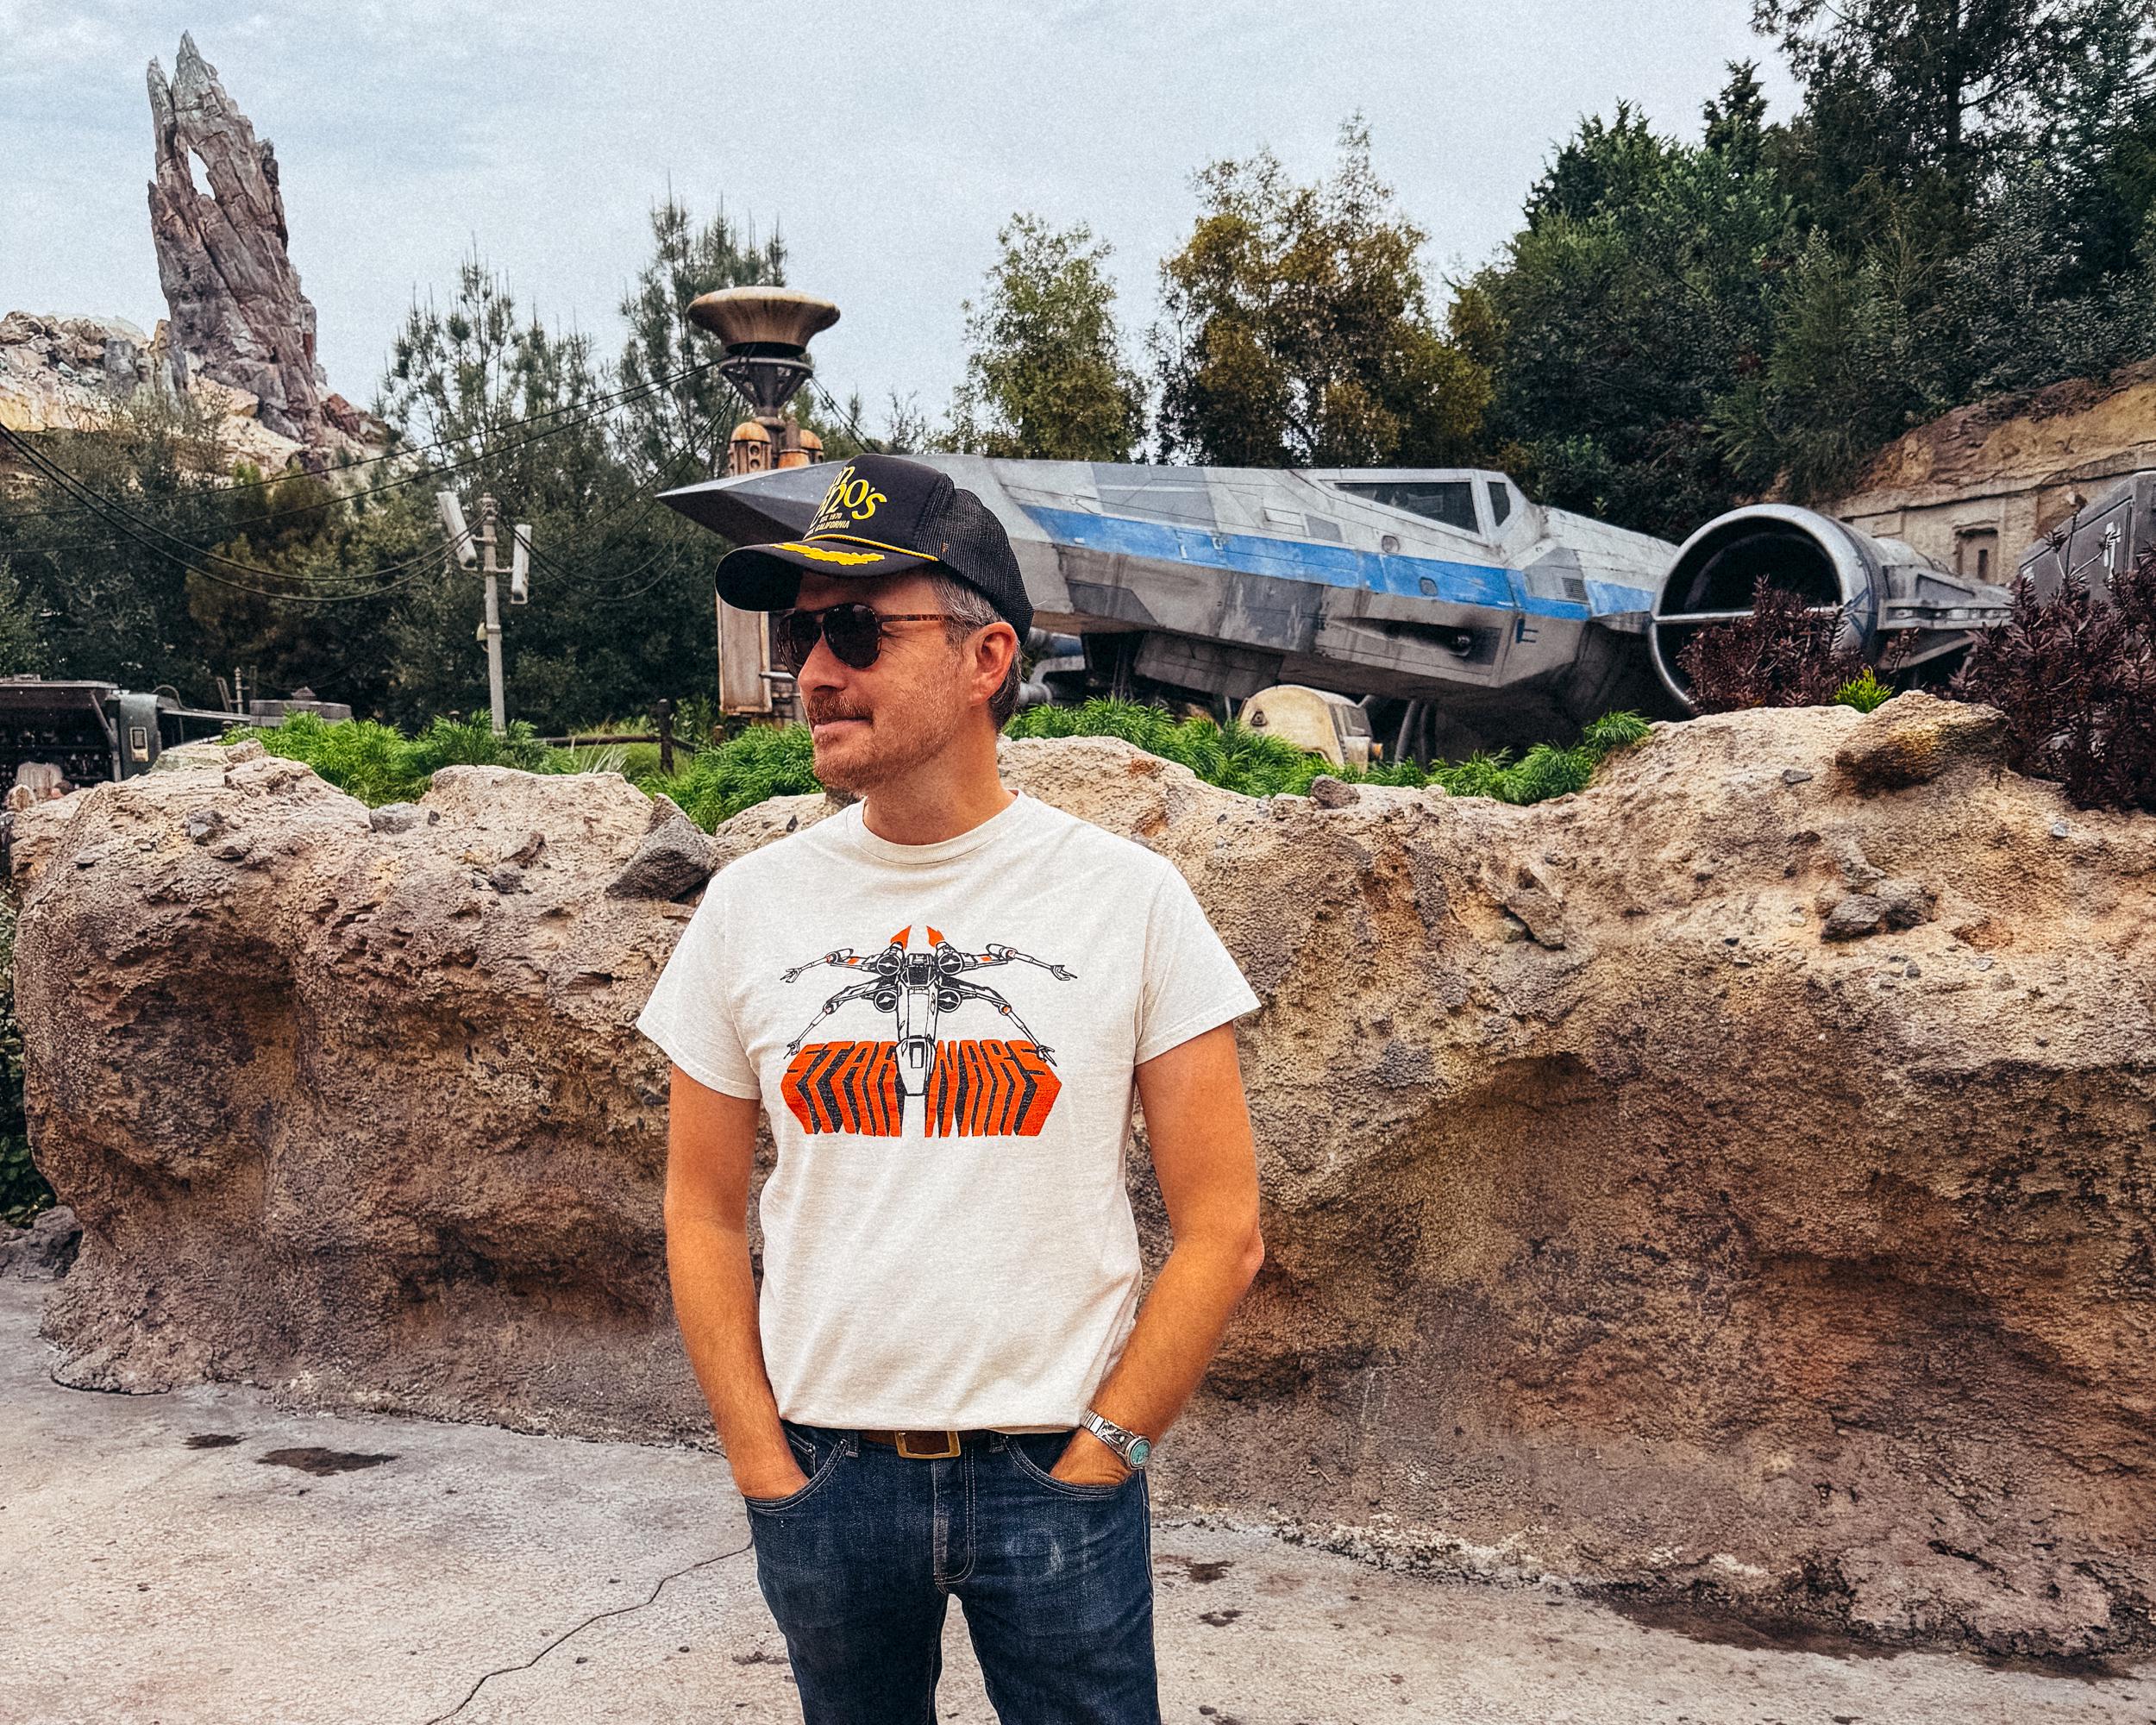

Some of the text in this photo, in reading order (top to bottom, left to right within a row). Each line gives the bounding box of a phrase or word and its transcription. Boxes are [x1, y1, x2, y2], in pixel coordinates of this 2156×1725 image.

[815, 520, 850, 532] CALIFORNIA
[780, 1039, 1062, 1138] STAR WARS
